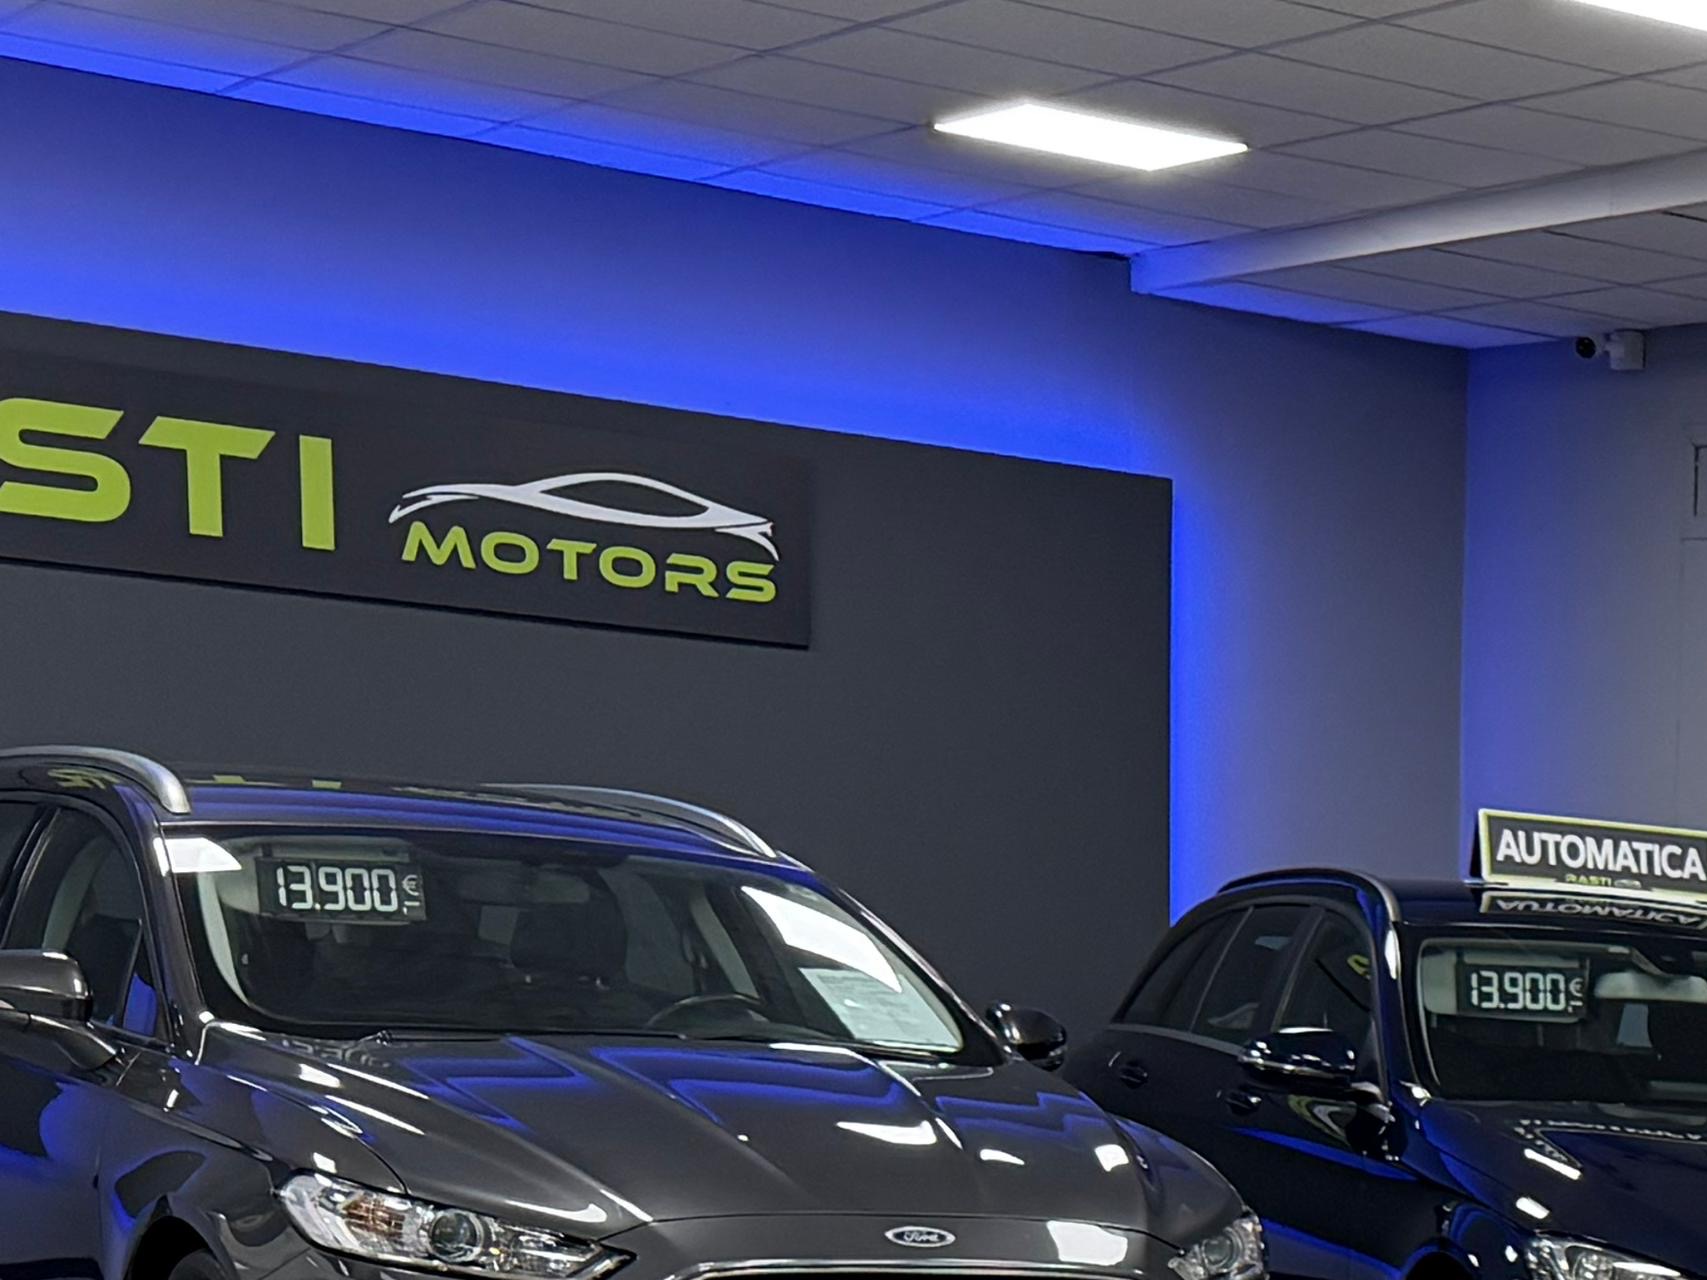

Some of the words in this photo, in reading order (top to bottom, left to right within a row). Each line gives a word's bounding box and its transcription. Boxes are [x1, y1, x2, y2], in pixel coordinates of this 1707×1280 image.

[402, 519, 778, 603] MOTORS
[1496, 828, 1707, 882] AUTOMATICA
[276, 865, 399, 912] 13.900
[1470, 970, 1567, 1011] 13.900
